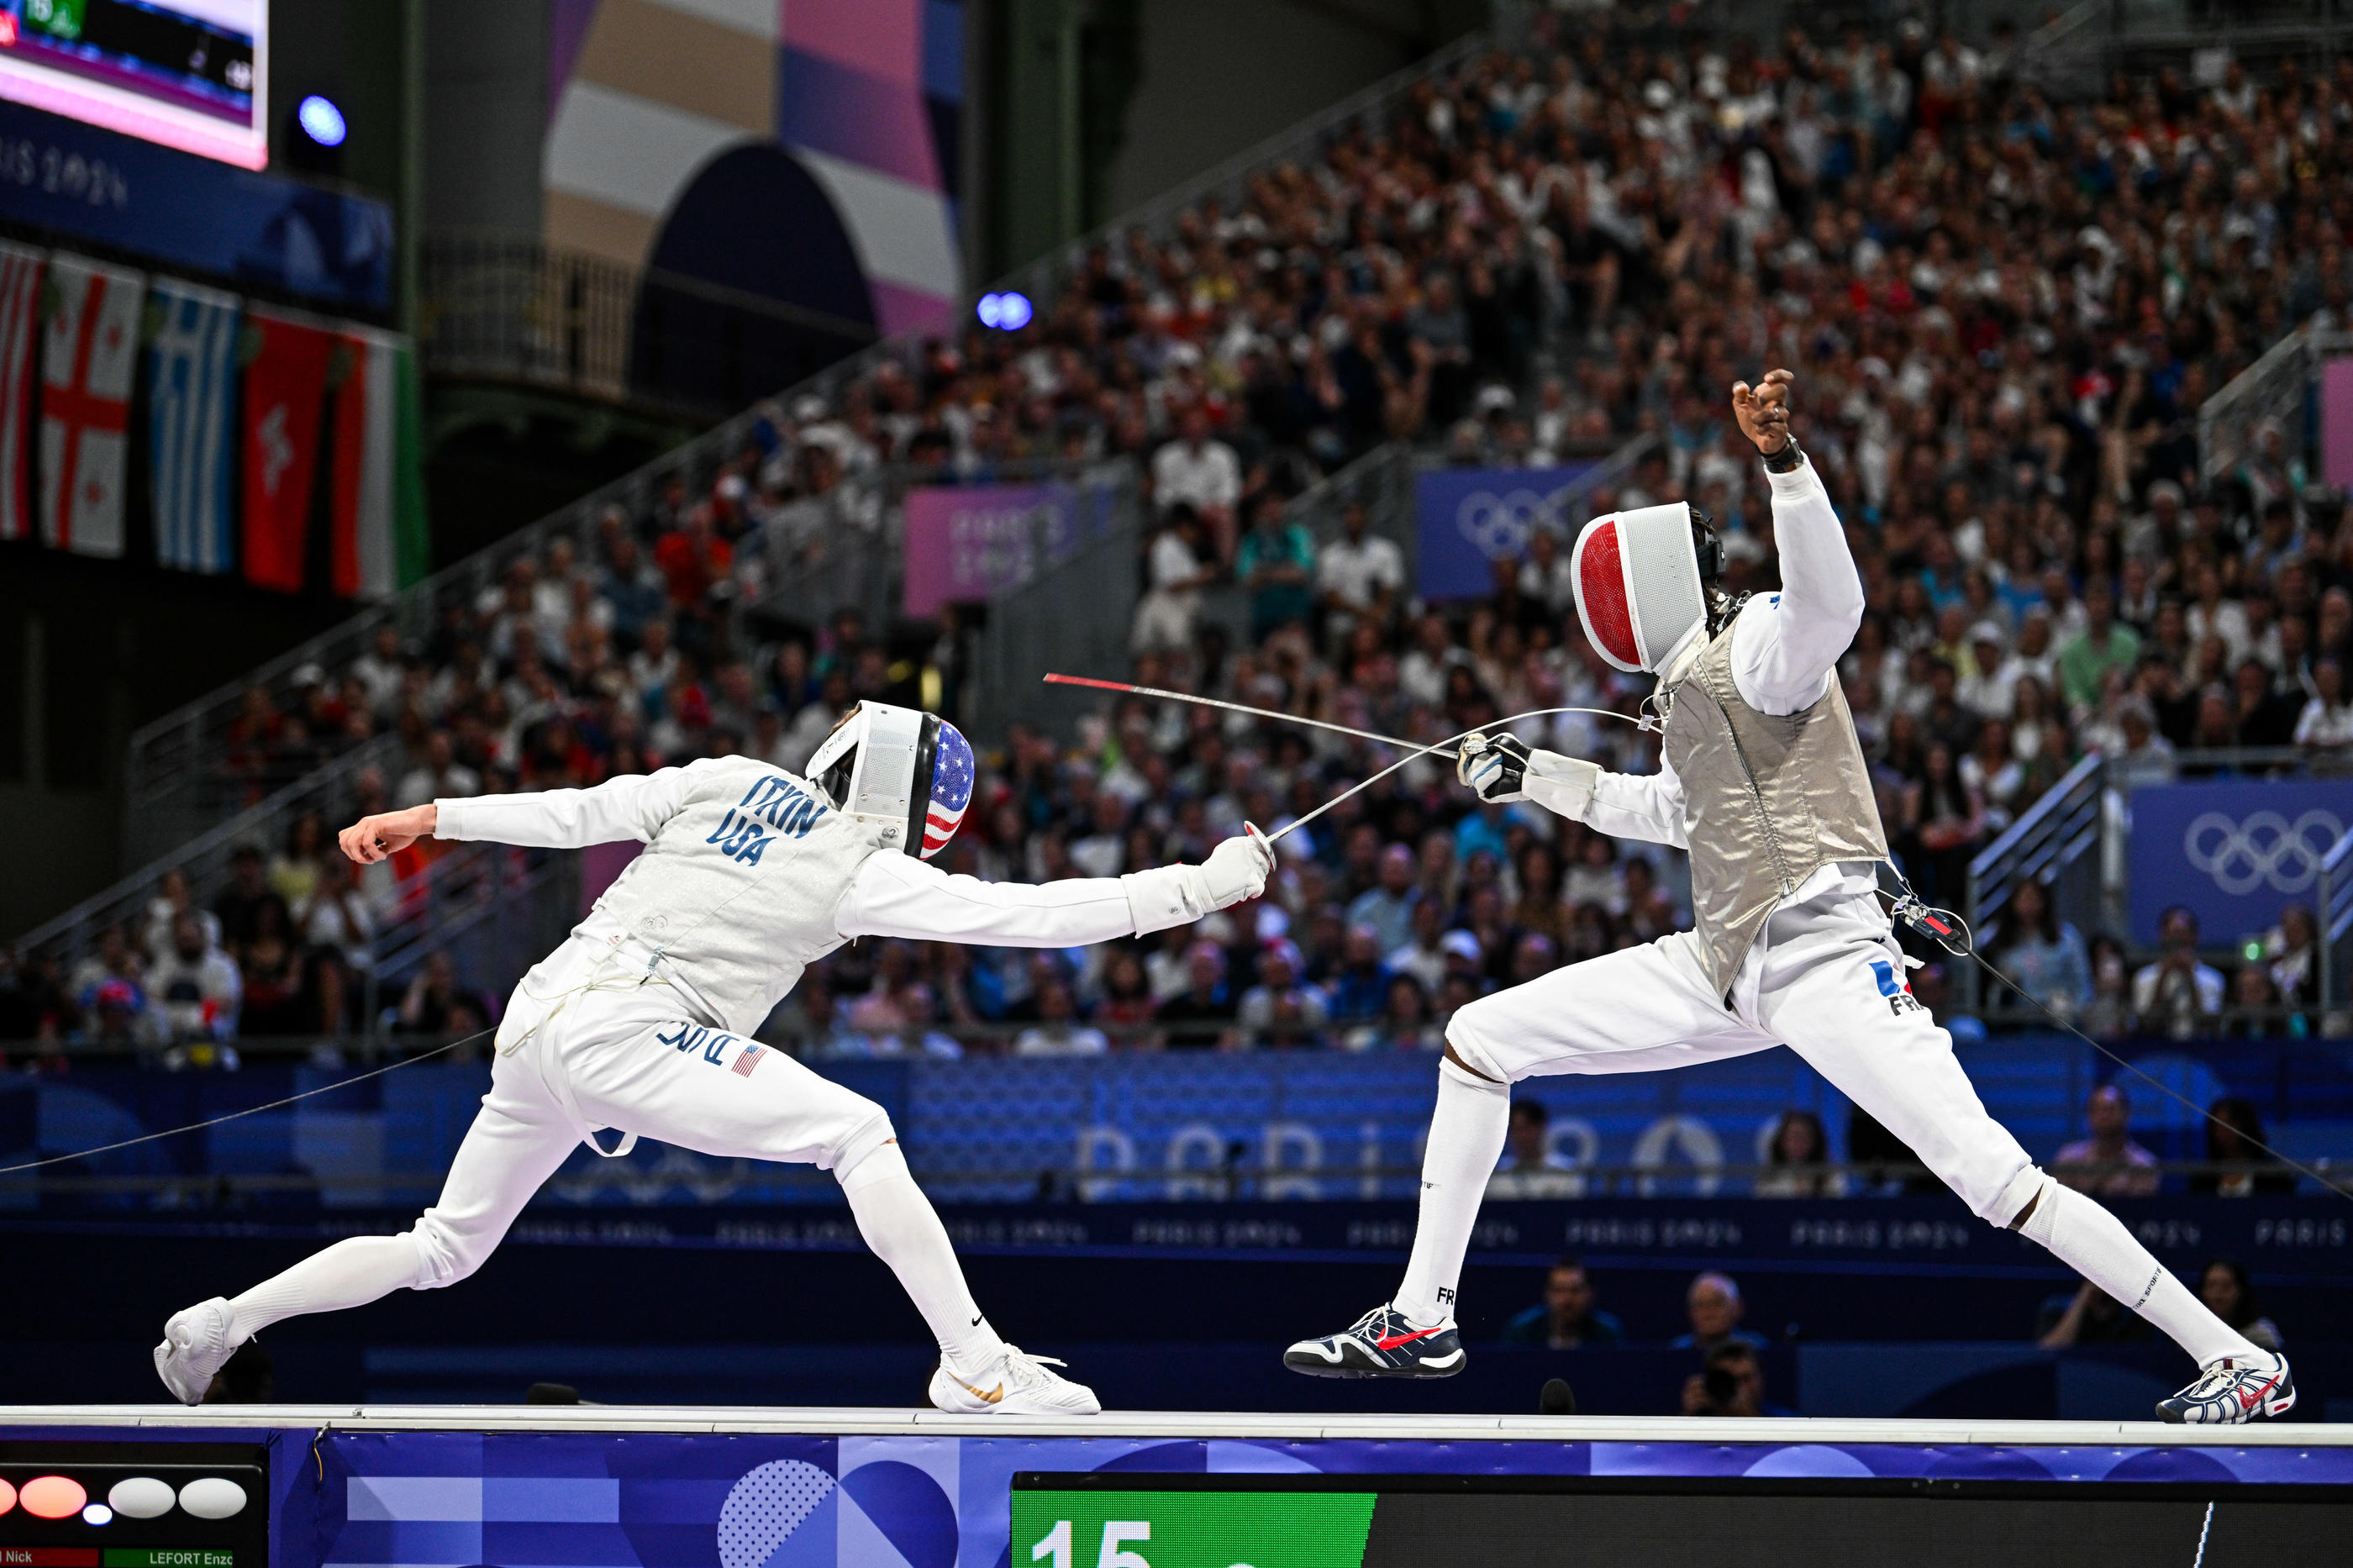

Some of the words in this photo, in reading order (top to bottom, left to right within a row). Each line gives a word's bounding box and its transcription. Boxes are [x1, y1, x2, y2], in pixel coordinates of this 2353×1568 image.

[740, 775, 828, 839] ITKIN
[706, 808, 777, 866] USA
[1888, 995, 1924, 1016] FR
[1076, 1121, 1426, 1202] PARI
[2145, 1266, 2162, 1296] SPORTIF
[6, 1550, 32, 1563] Nick
[150, 1553, 200, 1565] LEFORT
